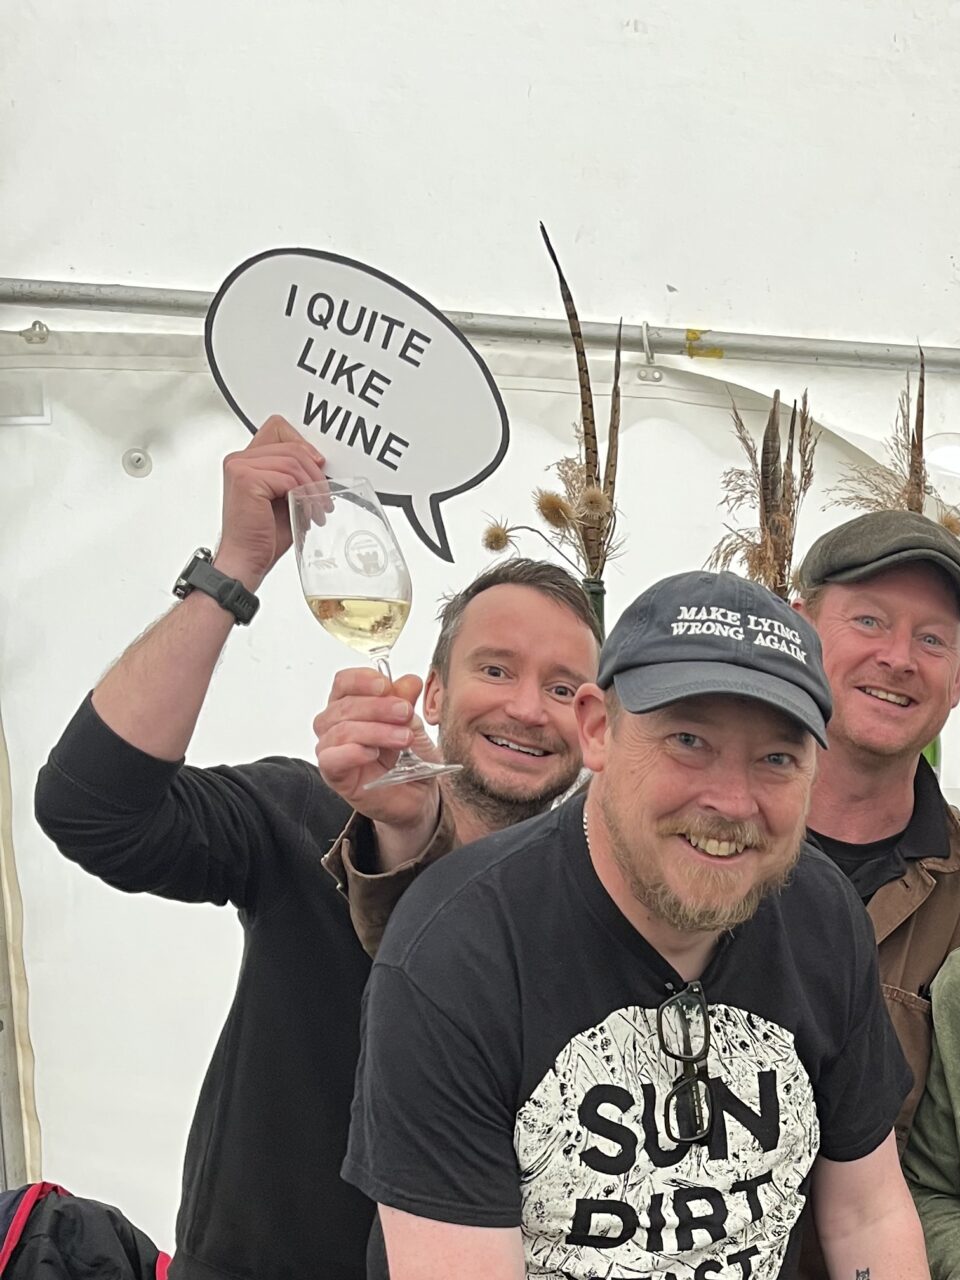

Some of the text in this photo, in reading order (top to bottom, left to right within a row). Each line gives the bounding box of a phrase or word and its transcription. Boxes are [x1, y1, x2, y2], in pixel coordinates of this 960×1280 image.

[285, 283, 432, 368] I QUITE
[297, 337, 392, 409] LIKE
[302, 392, 410, 471] WINE
[671, 622, 807, 664] WRONG AGAIN
[677, 606, 802, 644] MAKE LYING
[578, 1069, 780, 1176] SUN
[565, 1170, 778, 1253] DIRT
